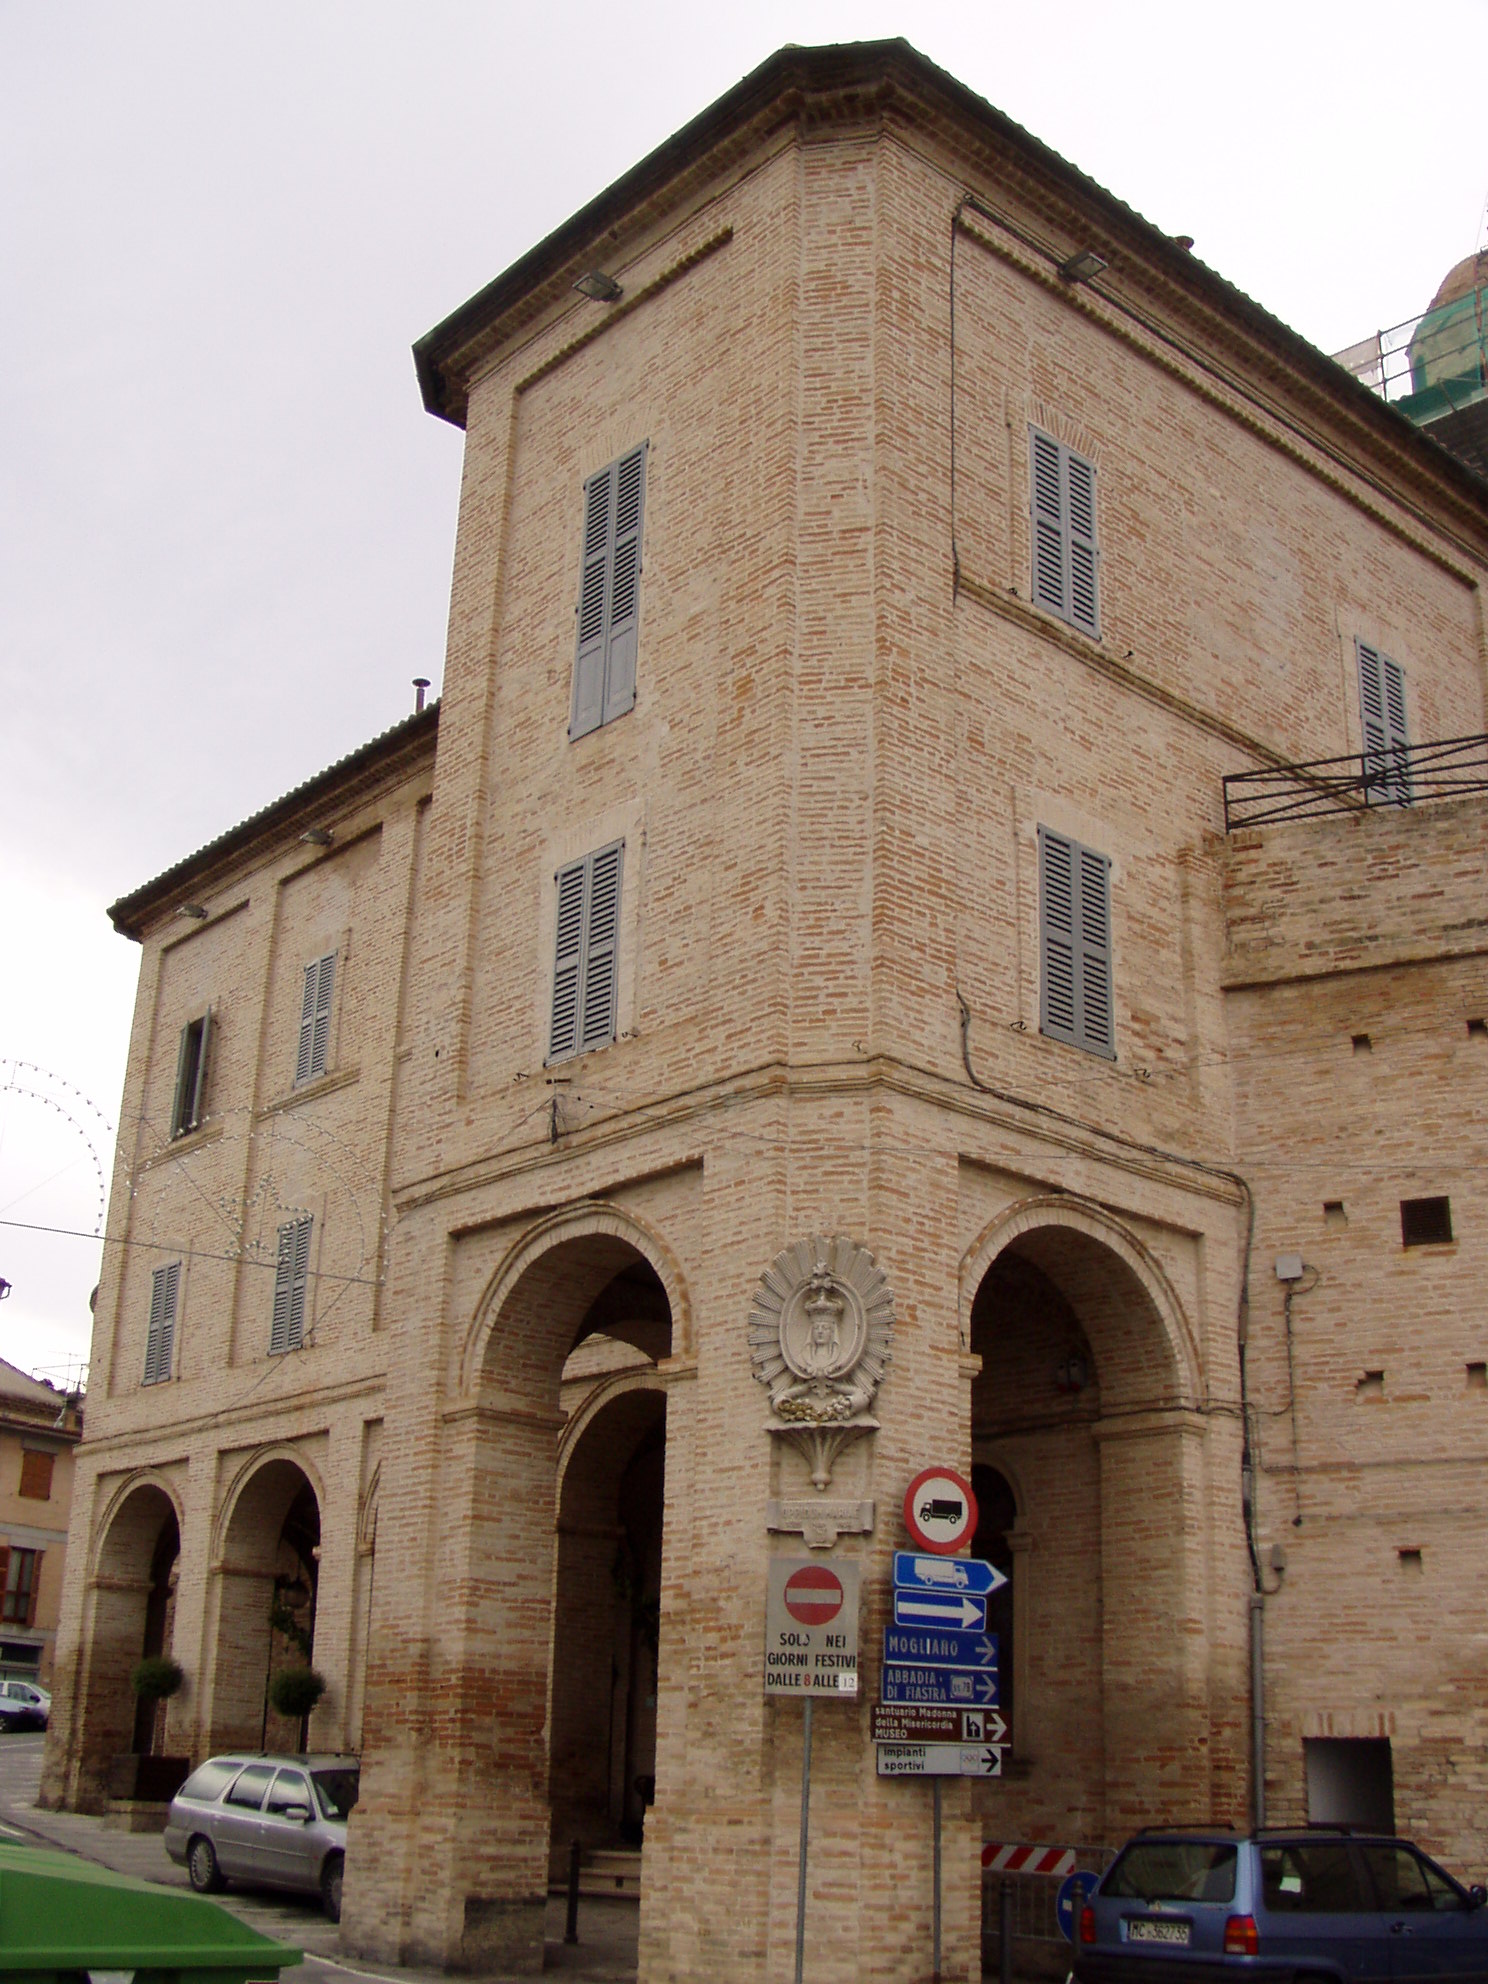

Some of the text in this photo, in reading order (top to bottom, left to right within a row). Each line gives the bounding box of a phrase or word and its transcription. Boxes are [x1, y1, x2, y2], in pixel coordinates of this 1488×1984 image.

[826, 1635, 846, 1648] NEI
[889, 1636, 958, 1656] MOGLIANO
[768, 1652, 857, 1669] GIORNI FESTIVI
[767, 1673, 855, 1688] DALLE 8 ALLE 12
[887, 1685, 947, 1701] DI FIASTRA
[875, 1706, 957, 1719] santuario Madonna
[875, 1717, 953, 1729] della Misericordia
[875, 1728, 907, 1739] MUSEO
[884, 1746, 926, 1758] impianti
[884, 1760, 925, 1771] sportivi
